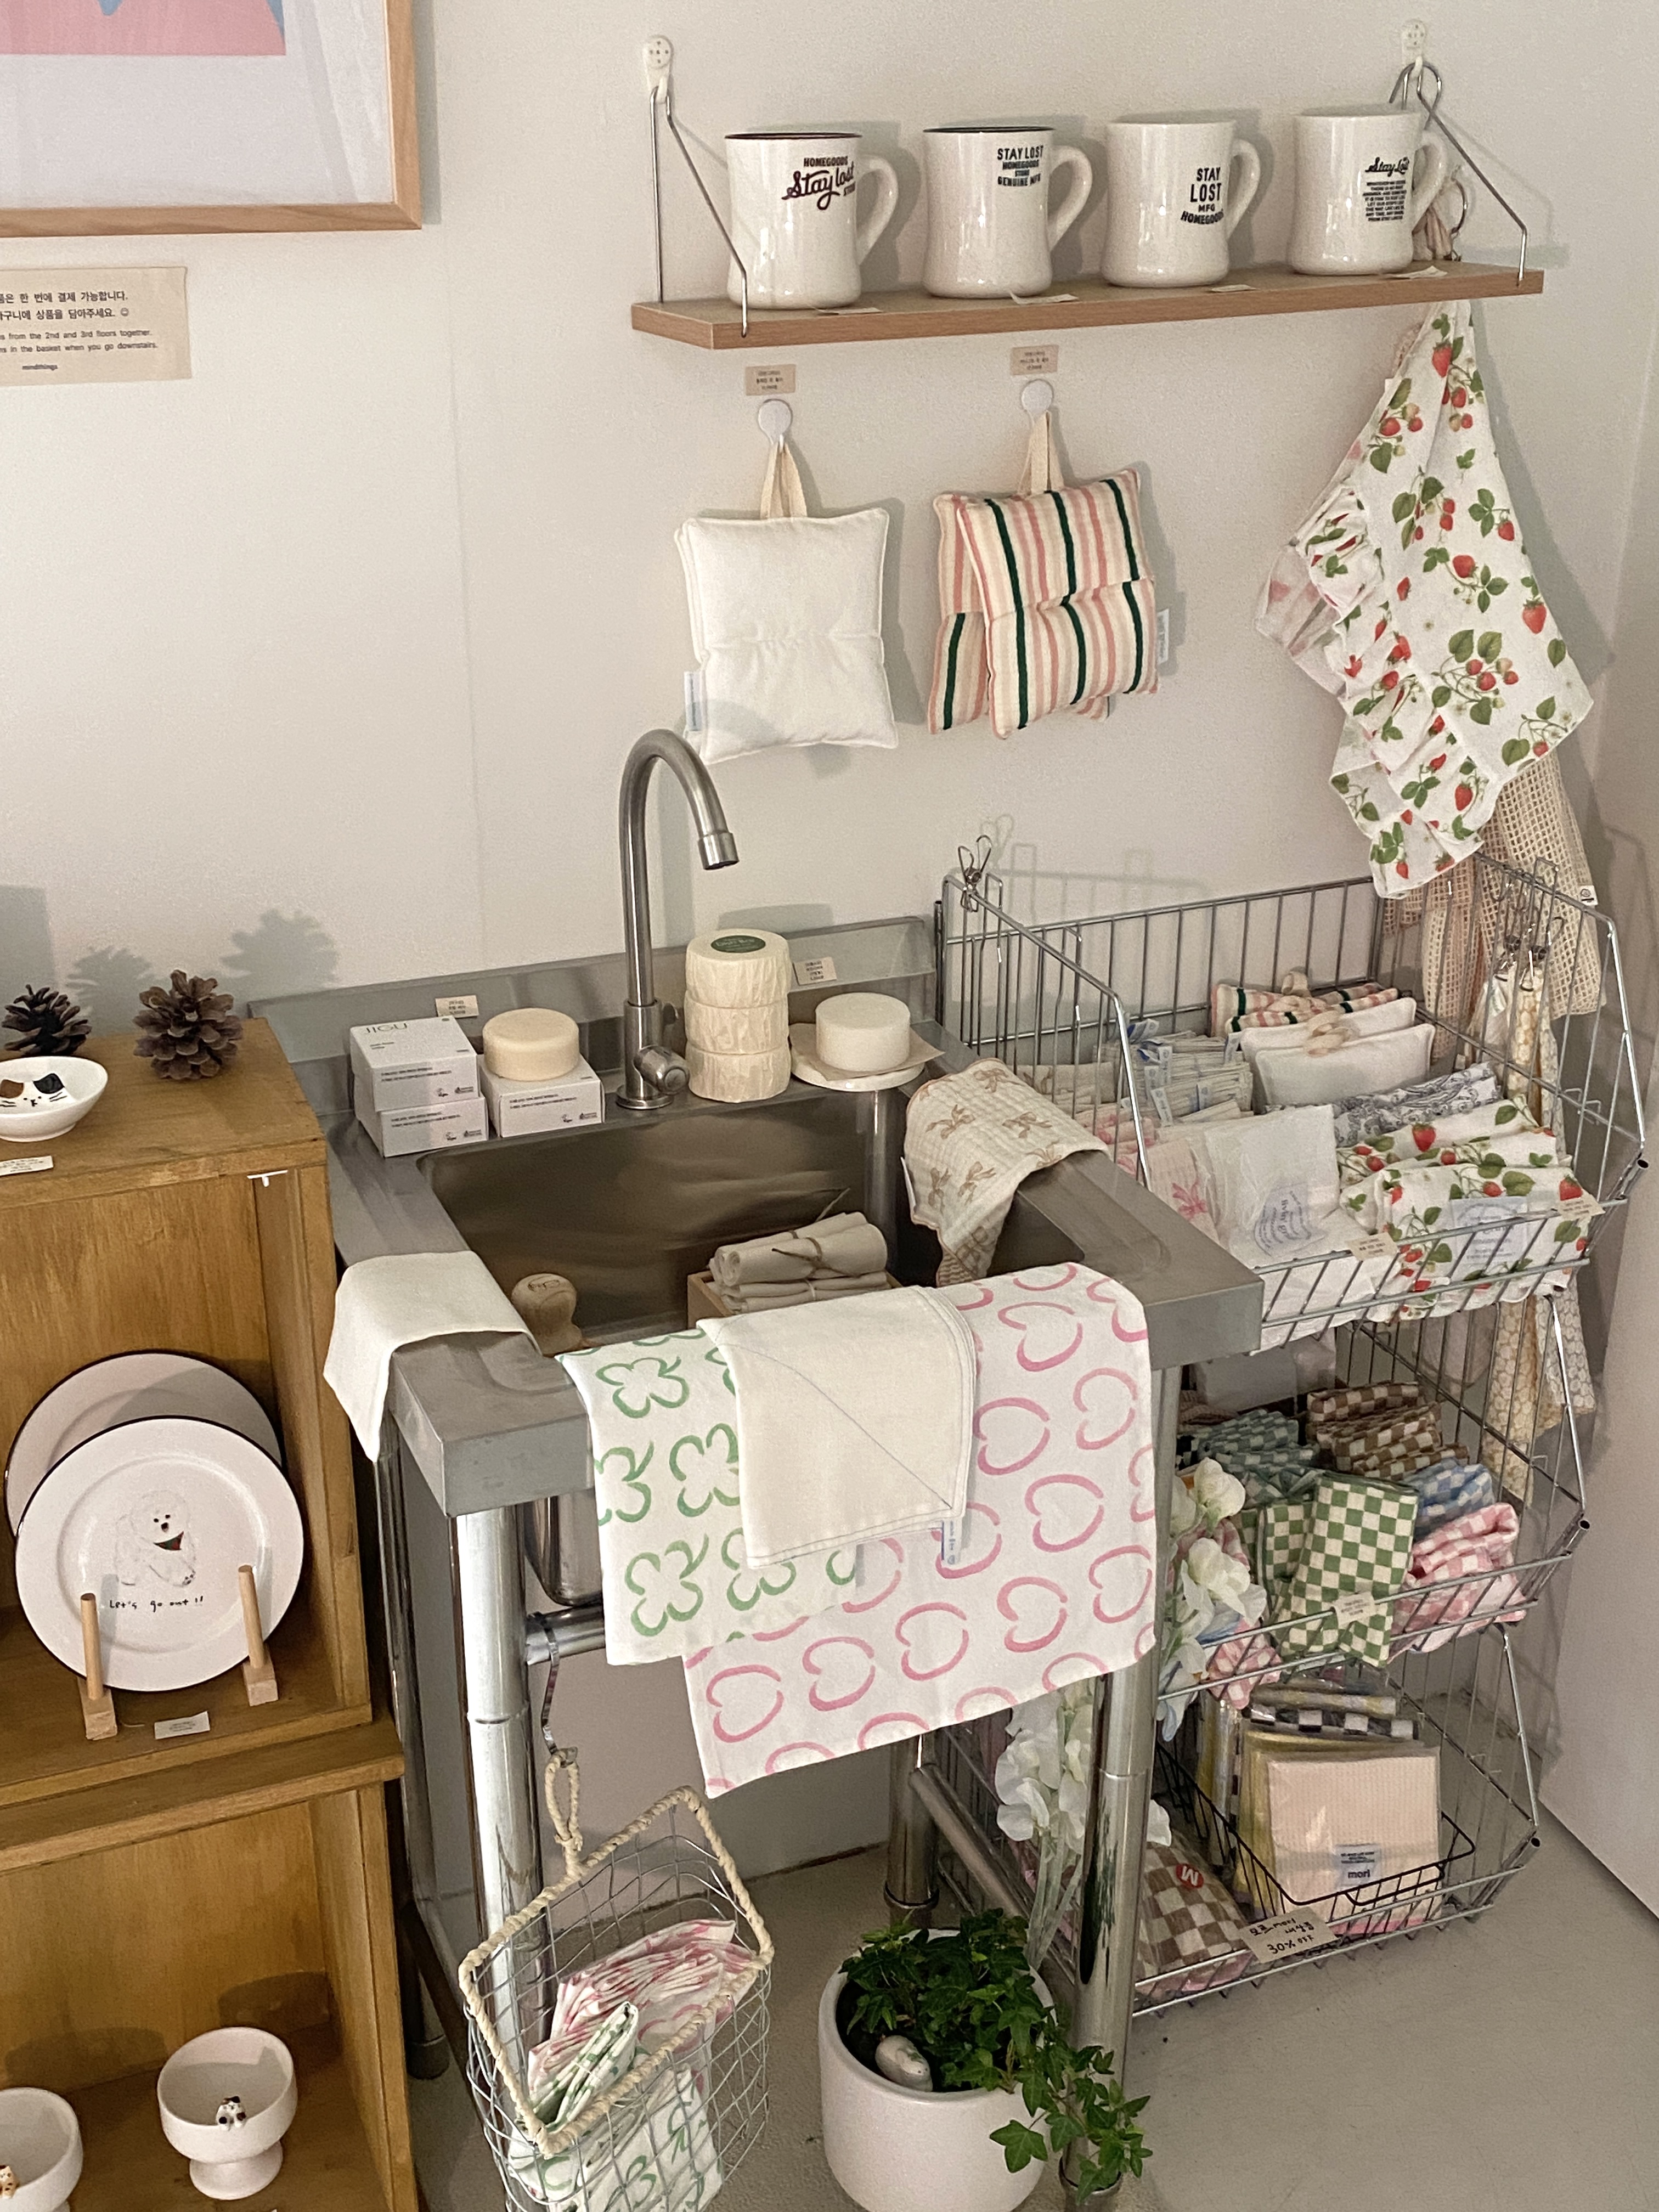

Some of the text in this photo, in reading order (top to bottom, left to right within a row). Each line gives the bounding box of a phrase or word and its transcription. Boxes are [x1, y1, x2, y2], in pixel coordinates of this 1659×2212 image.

[997, 145, 1043, 160] STAY LOST
[803, 156, 848, 167] HOMEGOODS
[1365, 157, 1396, 177] Stay
[1197, 167, 1221, 182] STAY
[781, 170, 841, 211] Stay
[1190, 183, 1222, 202] LOST
[1198, 203, 1215, 212] MFG
[19, 293, 29, 303] 한
[34, 292, 53, 303] 번에
[81, 291, 128, 301] 가능합니다.
[36, 309, 63, 320] 상품을
[110, 1599, 137, 1610] Let's
[150, 1600, 163, 1613] go
[1267, 1934, 1314, 1955] 30% OFF
